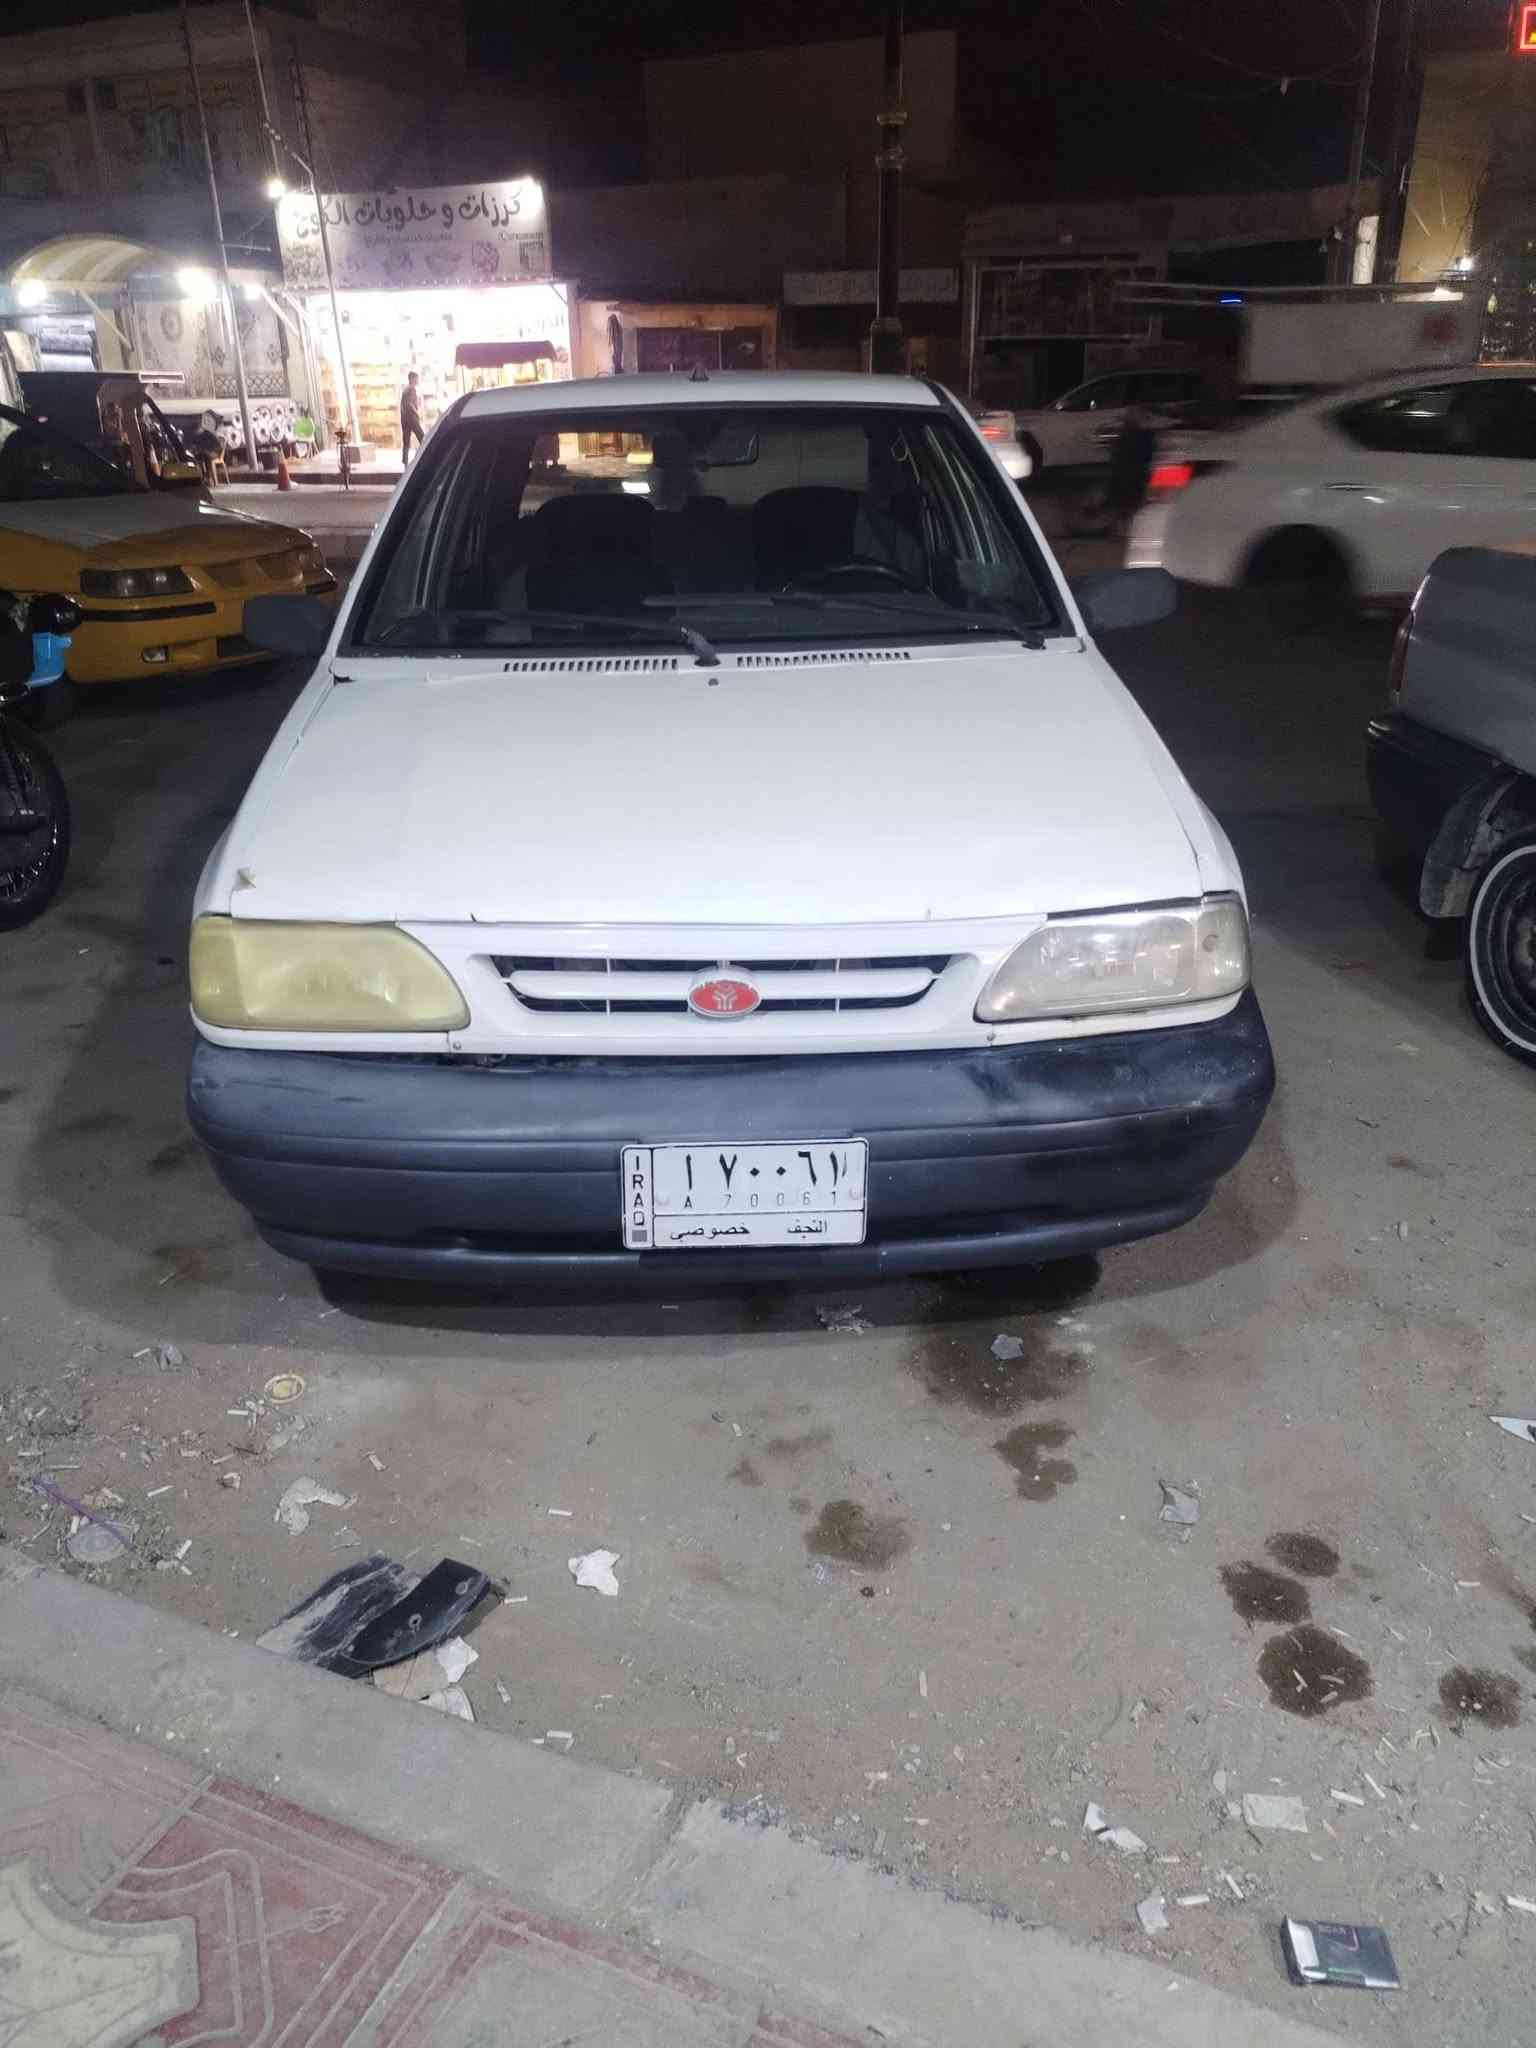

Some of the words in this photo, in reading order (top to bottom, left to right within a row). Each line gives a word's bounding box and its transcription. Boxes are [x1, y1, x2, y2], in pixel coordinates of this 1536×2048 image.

[354, 196, 437, 232] حلويات
[441, 206, 454, 228] و
[459, 188, 523, 227] كرزات
[632, 1155, 648, 1226] IRAQ
[786, 1219, 828, 1239] النجف
